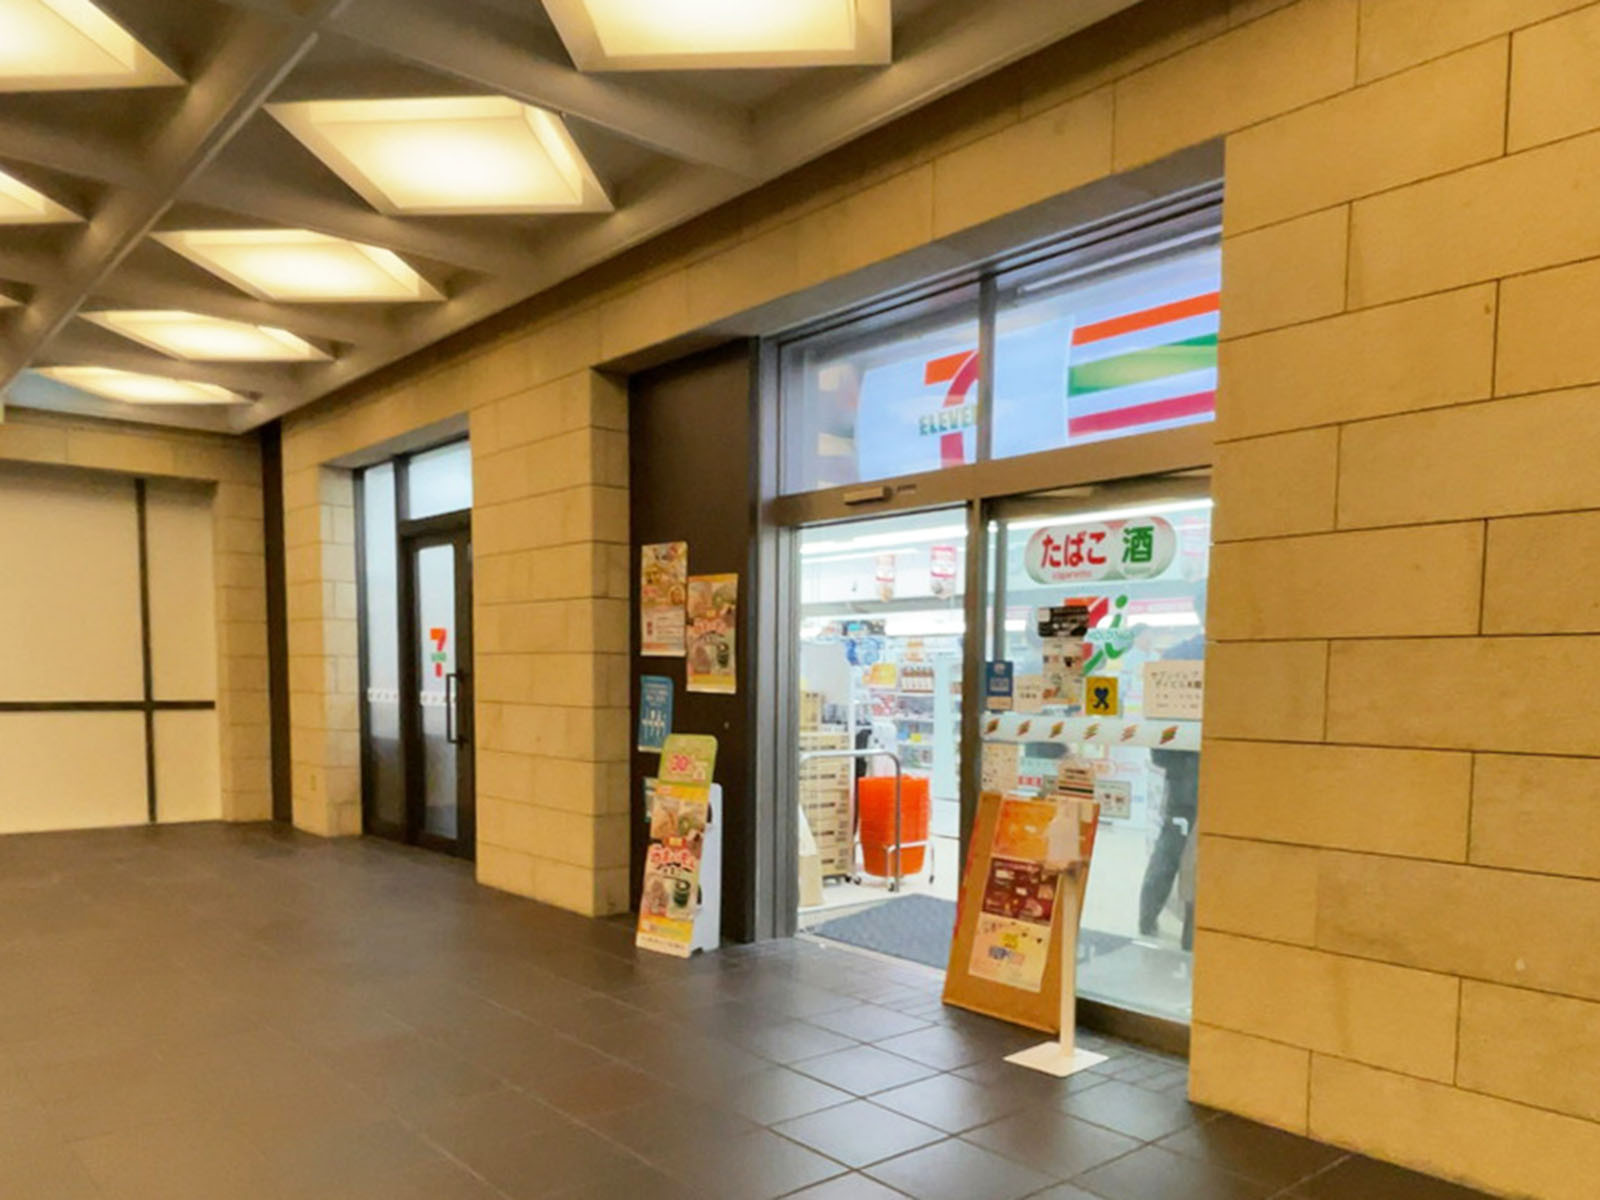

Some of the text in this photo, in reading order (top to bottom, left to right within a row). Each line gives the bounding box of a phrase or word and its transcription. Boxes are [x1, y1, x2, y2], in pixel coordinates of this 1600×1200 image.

[1040, 525, 1154, 569] たばこ 酒
